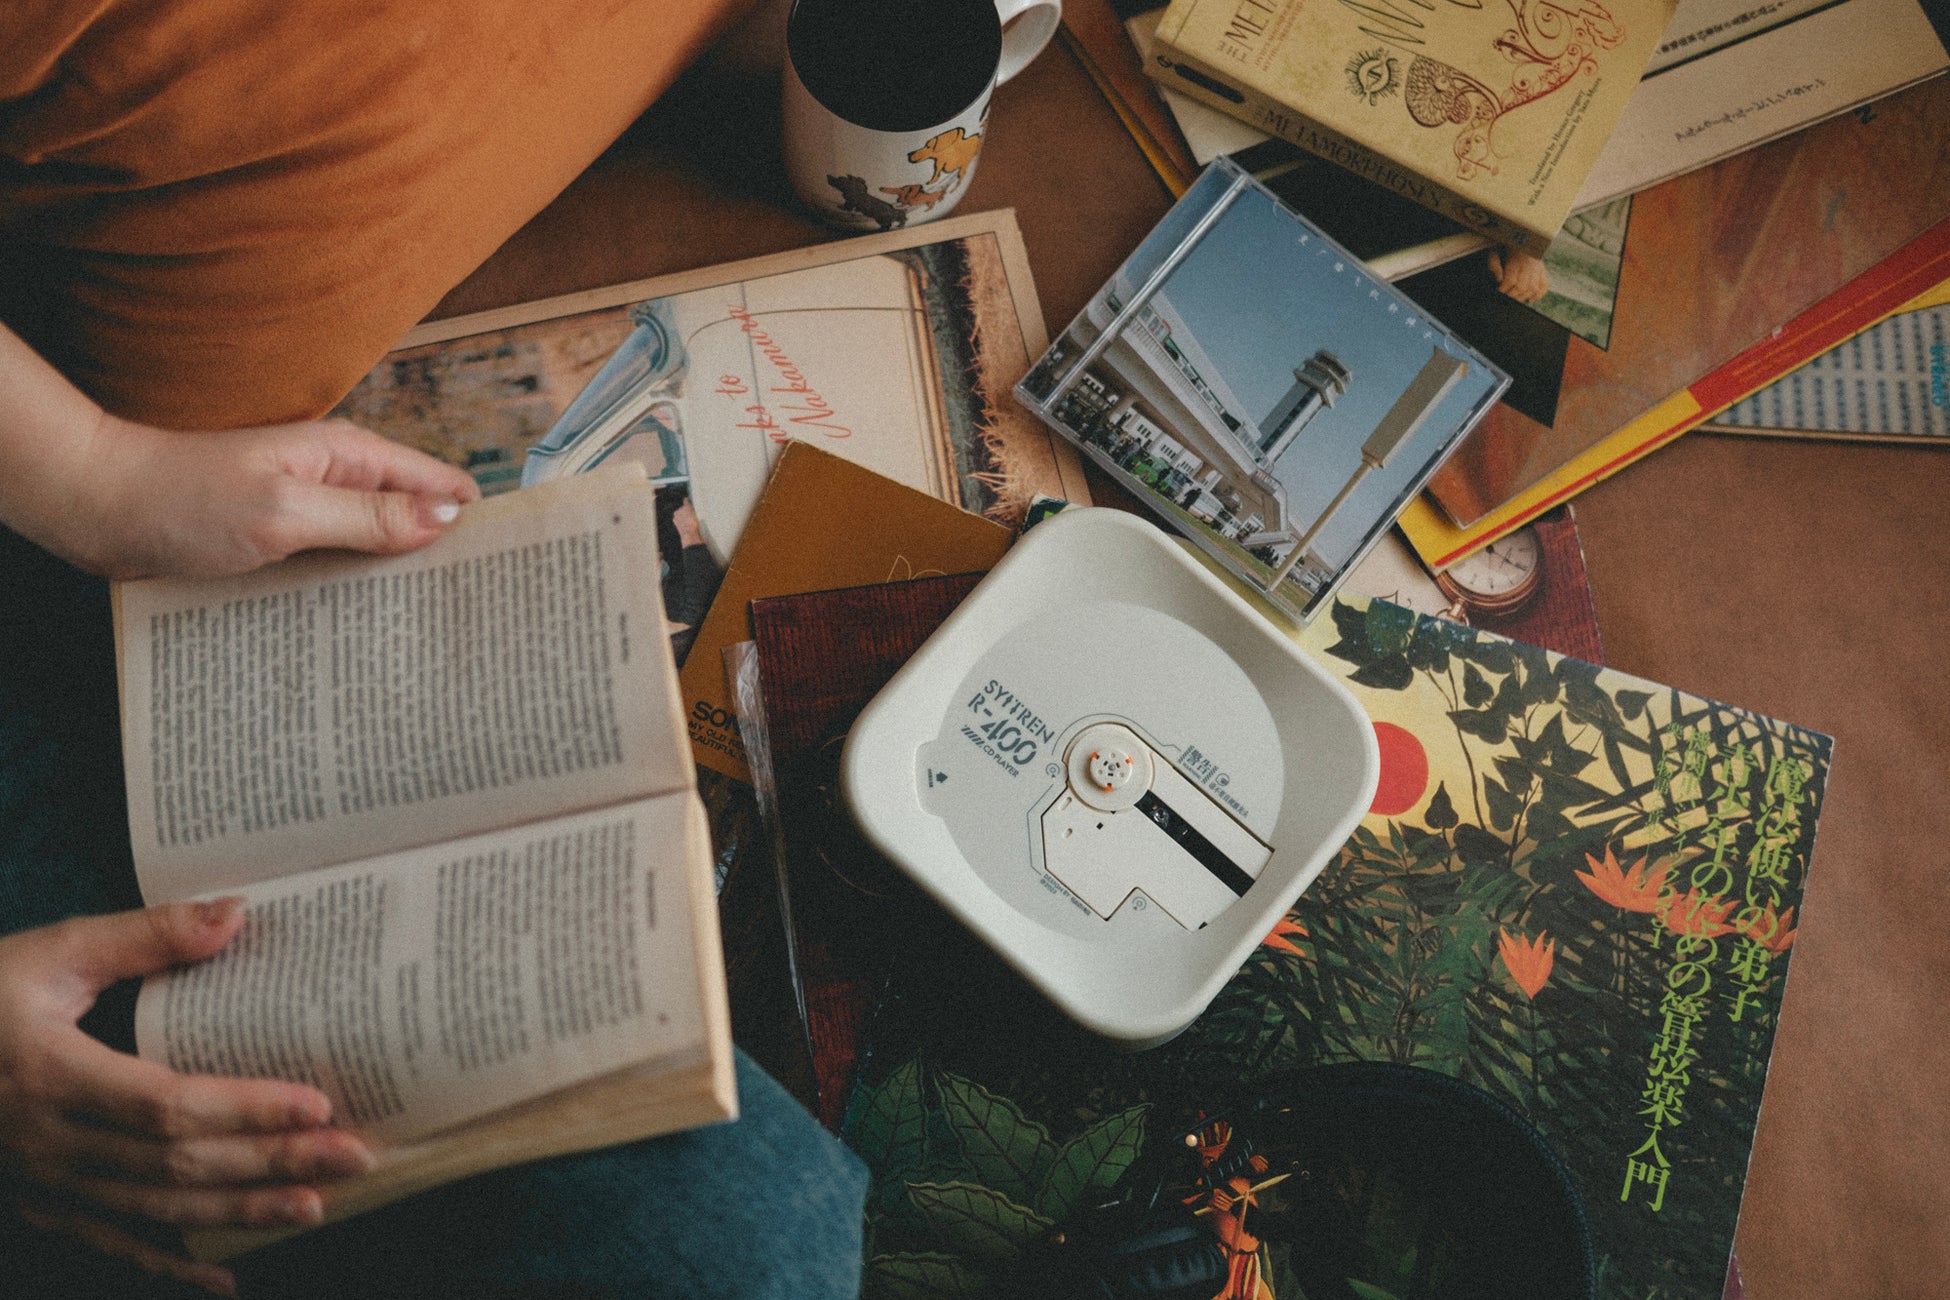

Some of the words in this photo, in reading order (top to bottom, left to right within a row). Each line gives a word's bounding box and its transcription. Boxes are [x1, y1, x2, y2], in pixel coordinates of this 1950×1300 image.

[1528, 151, 1551, 185] Translated
[1547, 141, 1557, 153] by
[714, 374, 749, 400] to
[706, 728, 727, 742] OLD
[968, 692, 1037, 765] R-400
[983, 744, 995, 756] CD
[993, 753, 1020, 778] PLAYER
[1720, 756, 1806, 1023] 魔法使いの弟子
[1621, 743, 1758, 1212] 青少年のための管弦楽入門
